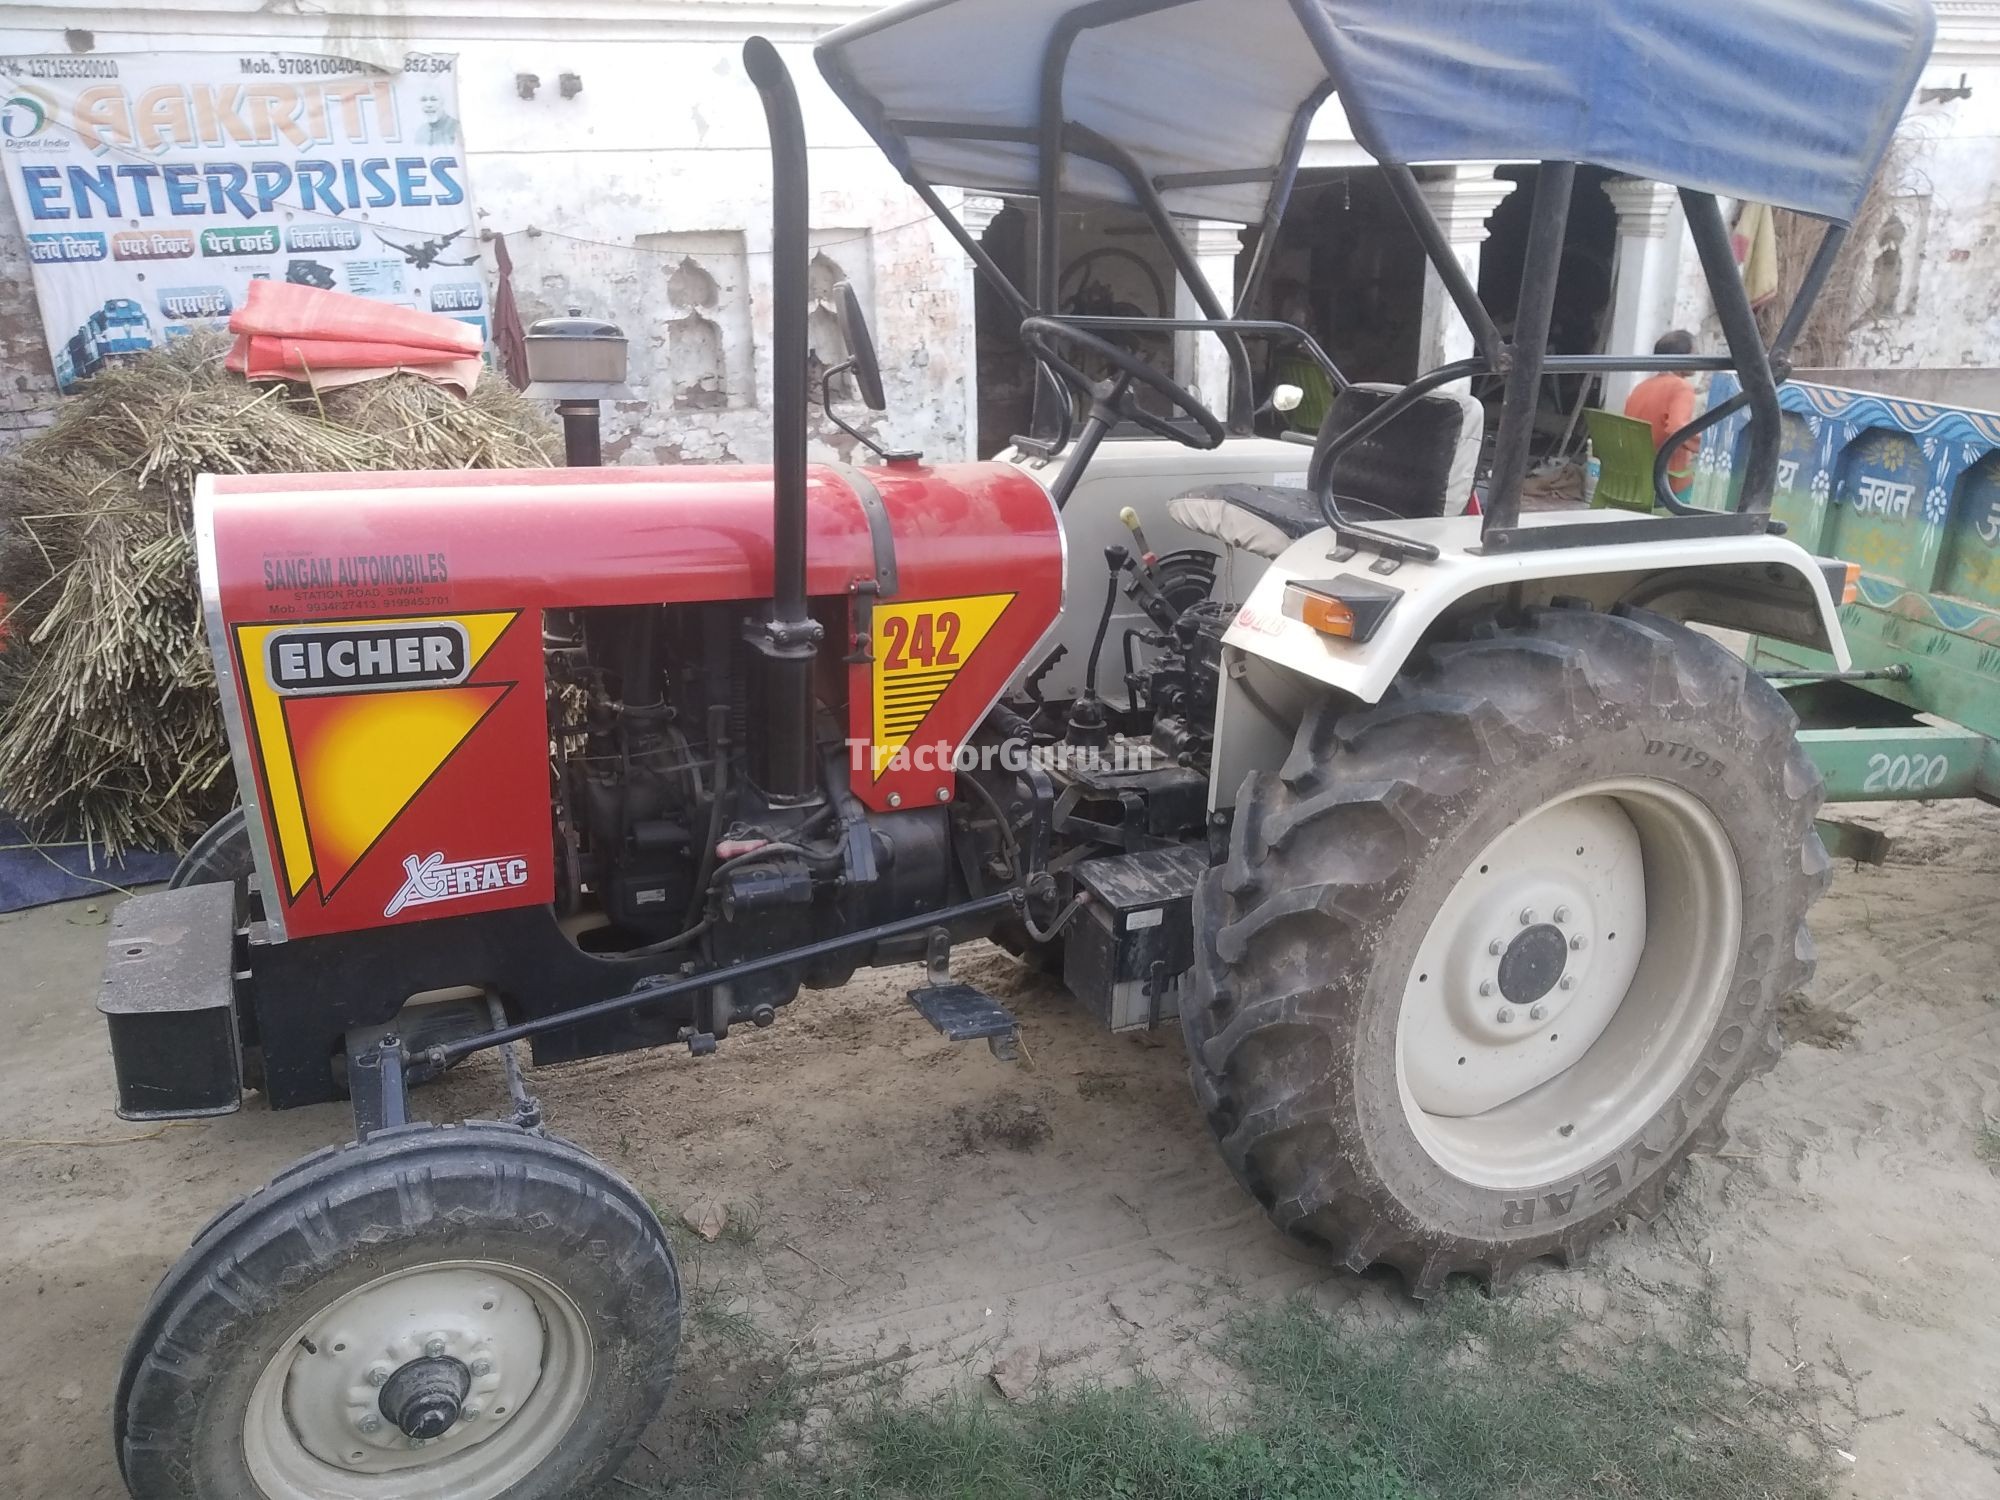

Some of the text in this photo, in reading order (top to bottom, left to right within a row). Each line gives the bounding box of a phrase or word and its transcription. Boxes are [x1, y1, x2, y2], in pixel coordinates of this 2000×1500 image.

[240, 58, 275, 74] Mob.
[73, 81, 403, 157] AAKRITI
[5, 139, 70, 149] Digital India
[21, 157, 464, 220] ENTERPRISES
[62, 236, 102, 258] टिकट
[117, 234, 191, 255] एयर टिकट
[204, 230, 275, 253] पैन कार्ड
[1853, 476, 1916, 518] जवान
[264, 552, 448, 591] SANGAM AUTOMOBILES
[295, 589, 344, 601] STATION
[386, 585, 424, 597] SIWAN
[278, 635, 456, 681] EICHER
[883, 611, 961, 671] 242
[1863, 753, 1949, 794] 2020
